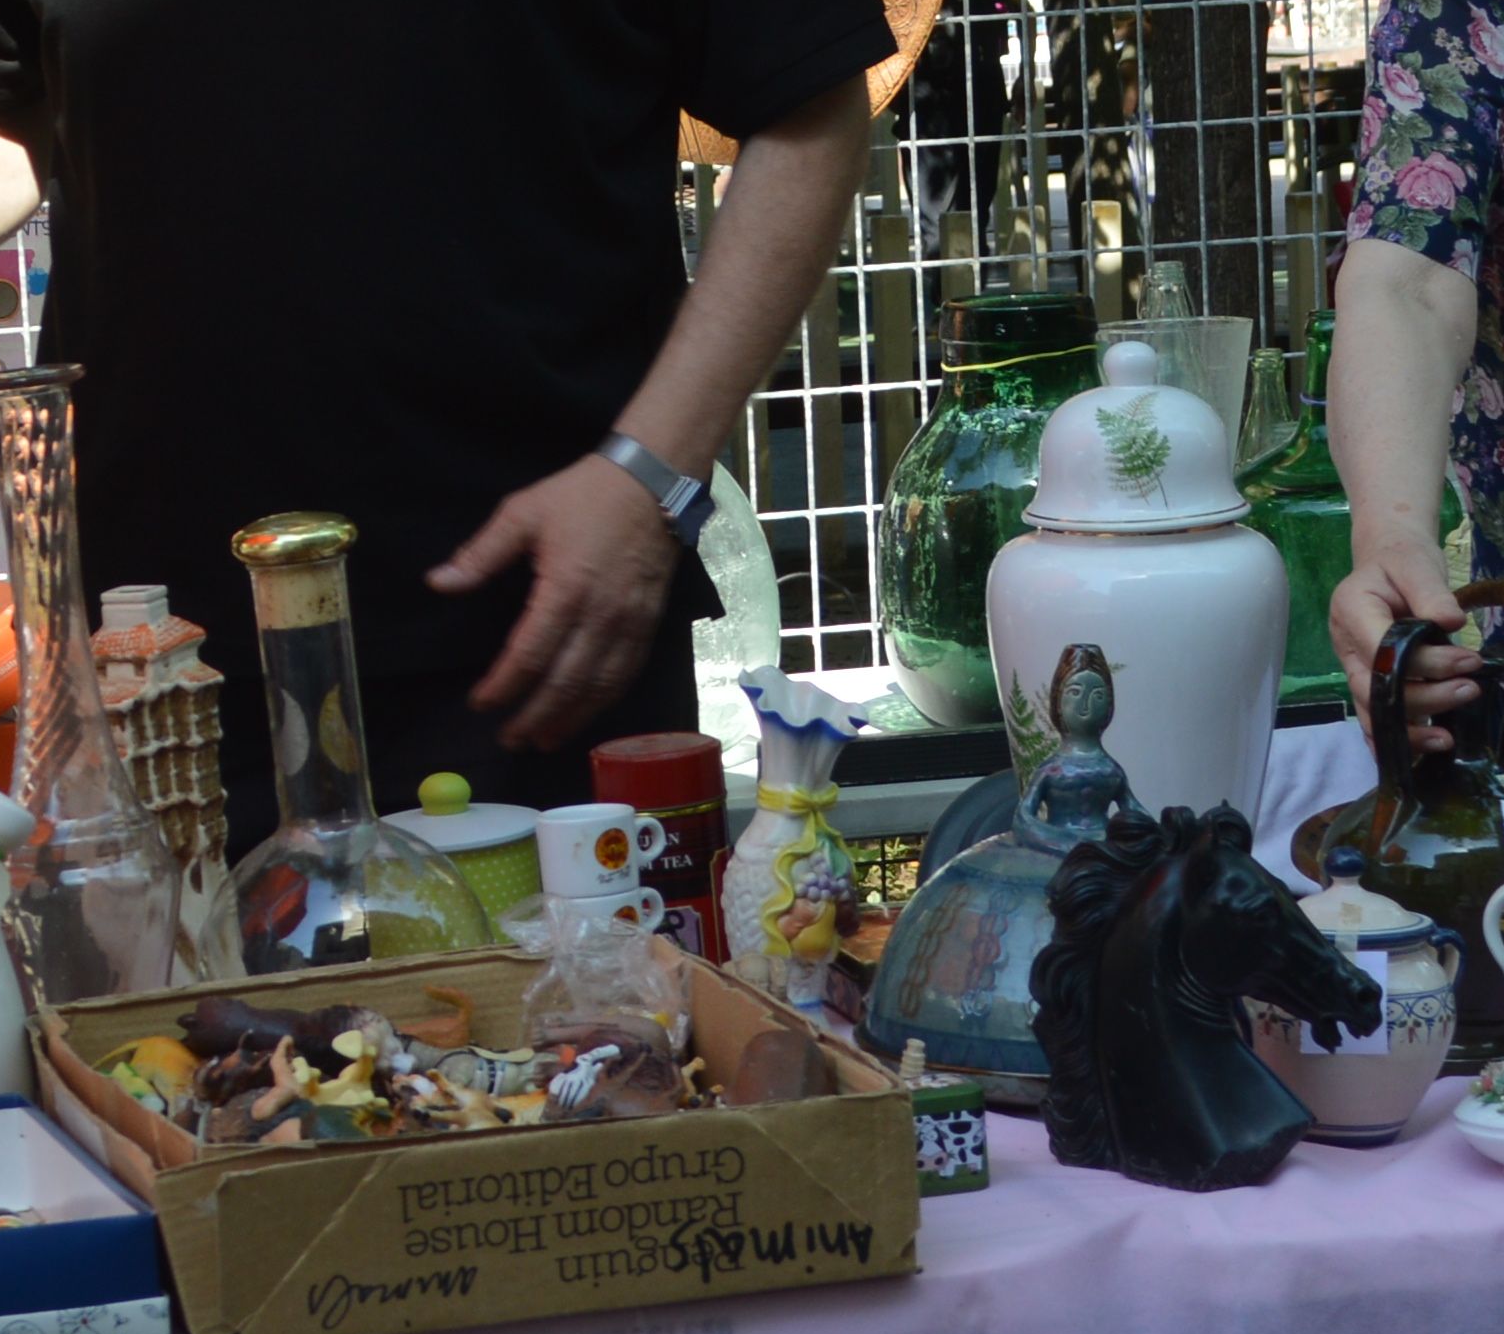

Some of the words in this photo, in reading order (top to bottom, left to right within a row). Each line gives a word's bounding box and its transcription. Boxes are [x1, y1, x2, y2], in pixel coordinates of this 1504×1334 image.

[660, 853, 693, 869] TEA
[605, 1144, 745, 1188] Grupo
[399, 1163, 594, 1223] Editorial
[555, 1191, 743, 1240] Random
[404, 1214, 546, 1257] House
[555, 1234, 742, 1288] Penguin
